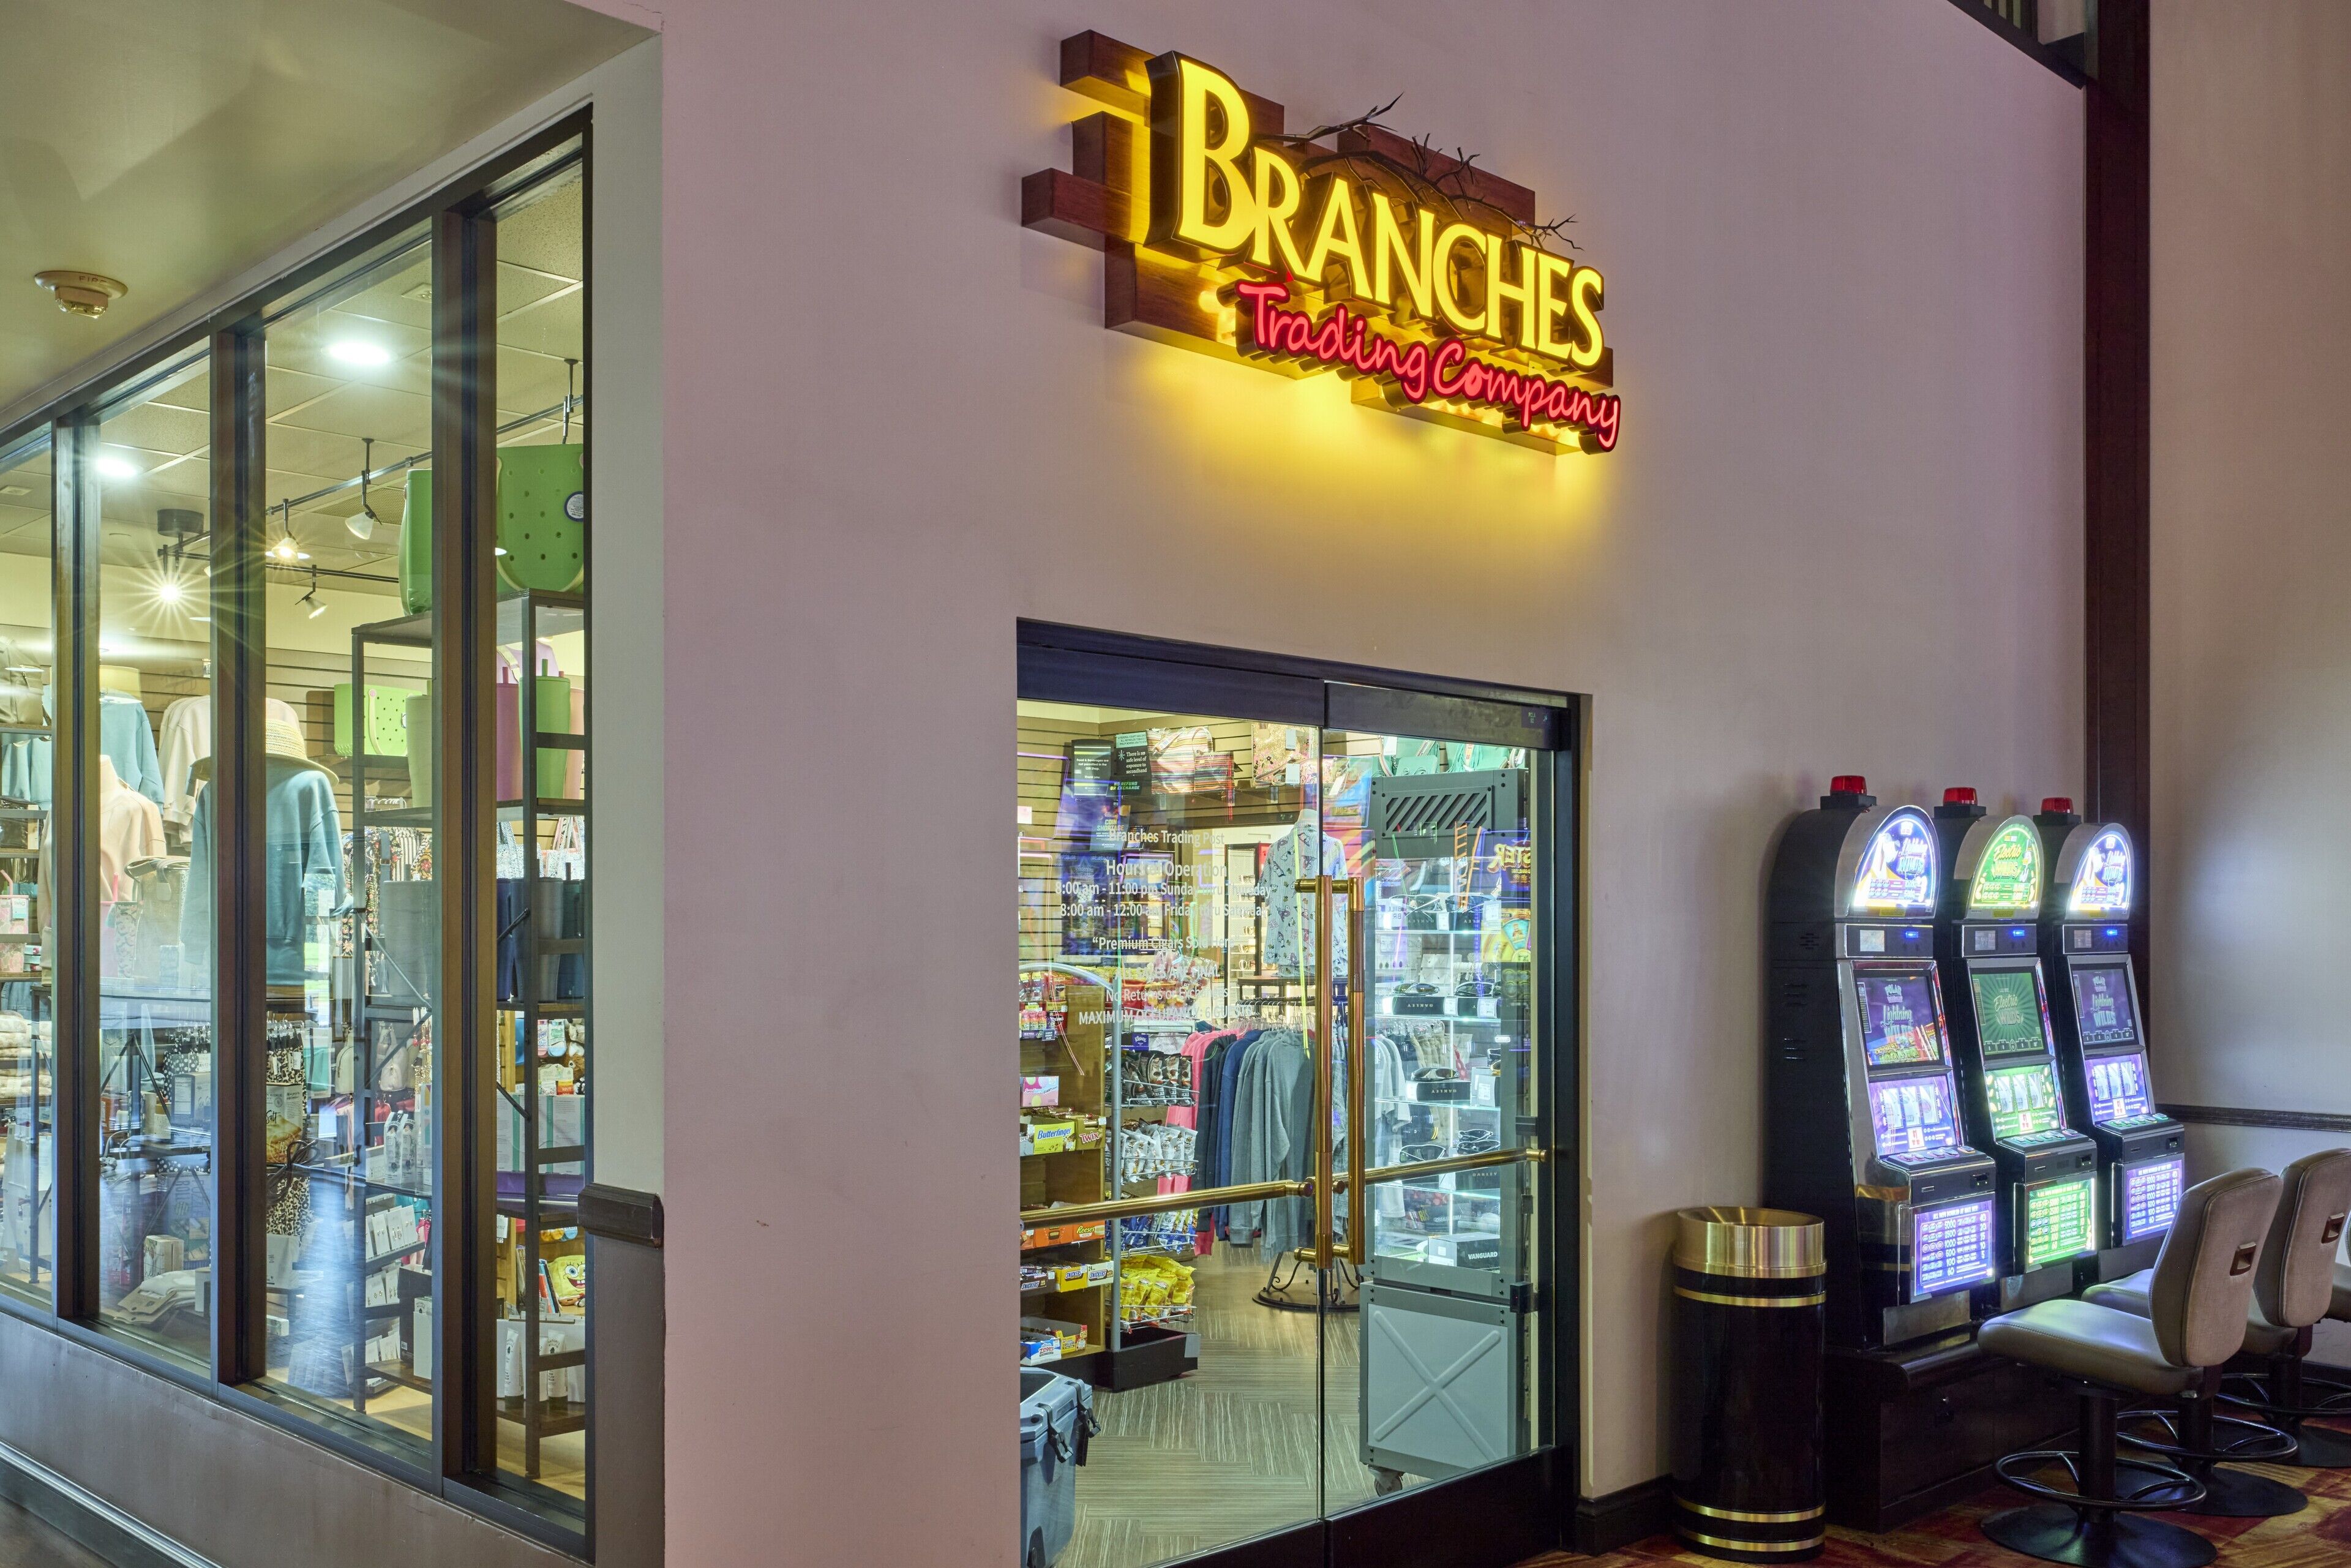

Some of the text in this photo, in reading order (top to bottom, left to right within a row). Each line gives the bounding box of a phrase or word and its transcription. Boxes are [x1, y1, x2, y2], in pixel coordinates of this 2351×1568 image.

[1235, 280, 1621, 454] Trading Company
[1109, 829, 1224, 847] Branches Trading Post
[1993, 843, 2022, 862] Electric
[1164, 861, 1228, 880] Operation
[1055, 881, 1080, 895] 8:00
[1081, 883, 1100, 895] am
[1109, 881, 1138, 895] 11:00
[1141, 883, 1158, 898] pm
[1161, 882, 1197, 898] Sunday
[1060, 902, 1085, 917] 8:00
[1086, 906, 1104, 917] am
[1113, 902, 1142, 917] 12:00
[1151, 936, 1184, 951] Cigars
[1106, 989, 1121, 1002] No
[1123, 988, 1163, 1002] Returns
[1165, 989, 1176, 1000] or
[1993, 994, 2019, 1011] Electric
[2092, 993, 2113, 1008] Lightning
[1079, 1010, 1133, 1025] MAXIMUM
[1205, 1006, 1211, 1019] 6
[1883, 1005, 1913, 1022] Lightning
[1998, 1009, 2021, 1026] WILDS
[2094, 1010, 2117, 1027] WILDS
[1037, 1128, 1072, 1140] Butterfinger
[1079, 1131, 1100, 1144] Twix
[1944, 1220, 1956, 1228] 5000
[1944, 1229, 1956, 1239] 2500
[1944, 1232, 1985, 1248] 1000 15
[1946, 1248, 1955, 1258] 500
[1946, 1257, 1955, 1267] 100
[1065, 1270, 1082, 1280] SNICKERS
[1090, 1269, 1107, 1278] SNICKERS
[1947, 1267, 1954, 1276] 60
[1021, 1280, 1040, 1290] SNICKERS
